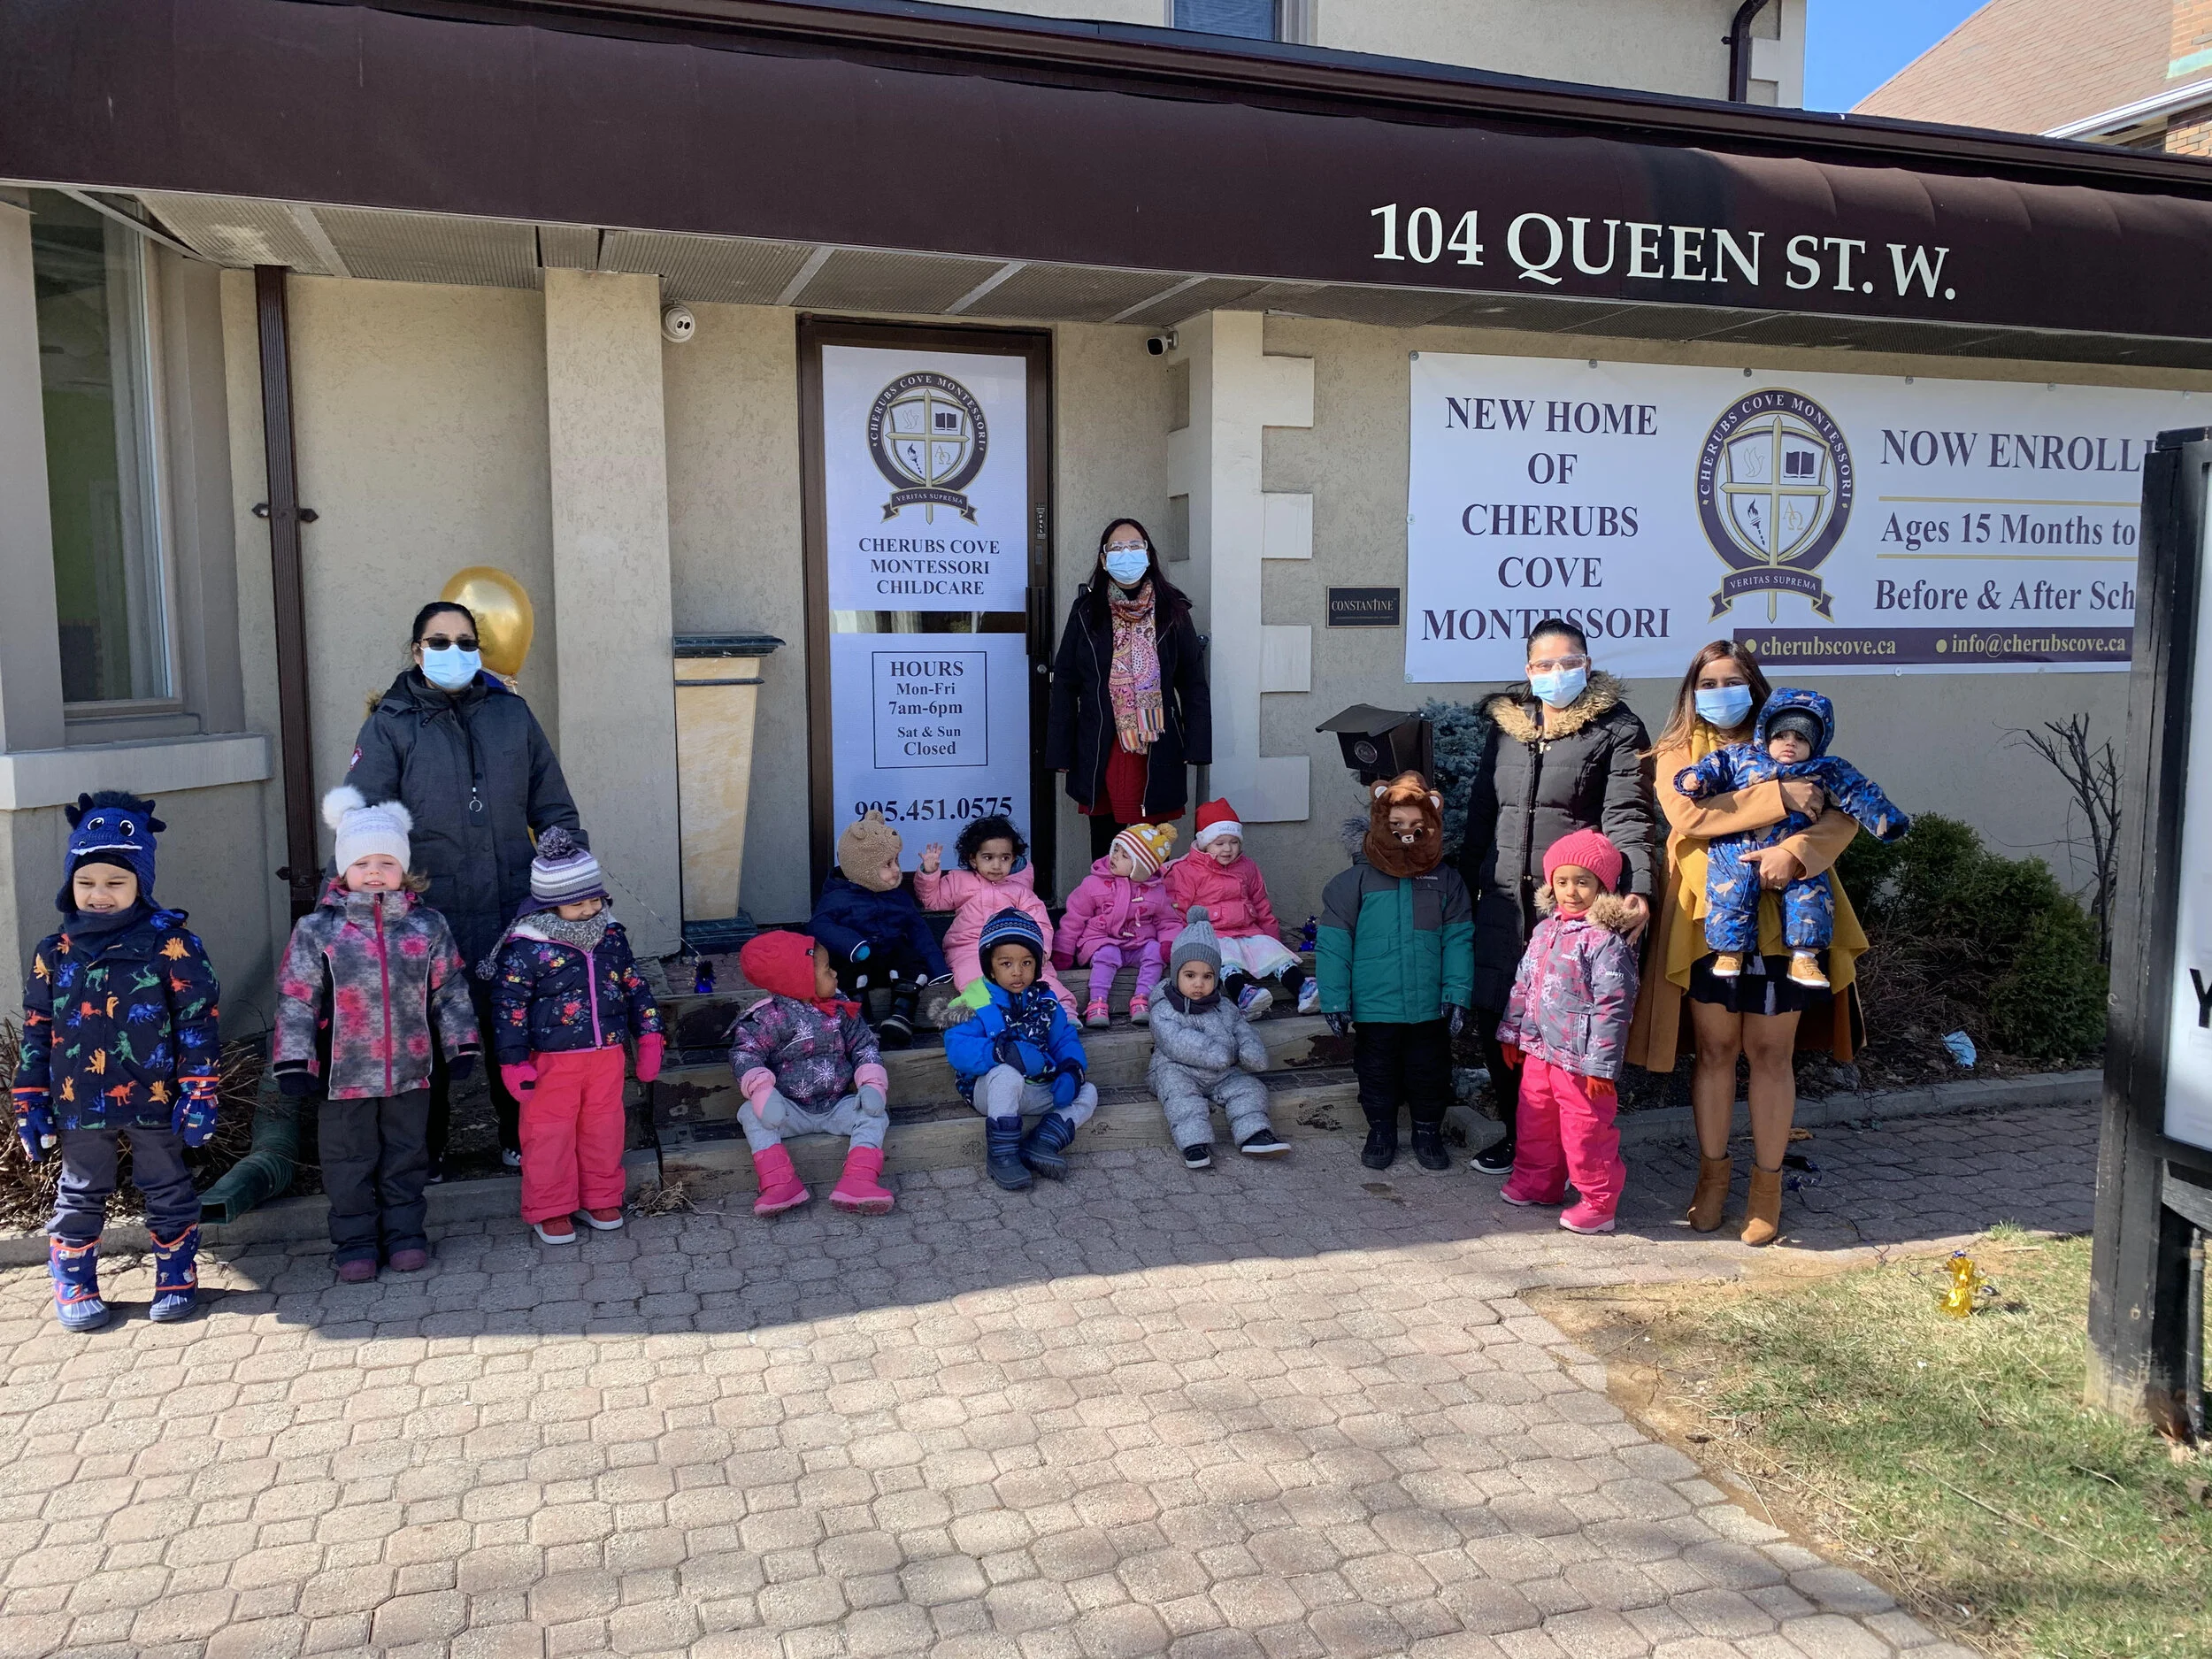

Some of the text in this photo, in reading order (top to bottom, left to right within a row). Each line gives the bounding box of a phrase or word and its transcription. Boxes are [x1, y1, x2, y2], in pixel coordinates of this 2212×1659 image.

[1371, 203, 1484, 265] 104
[1505, 212, 1764, 286] QUEEN
[870, 375, 986, 445] CHERUBS COVE MONTESSORI
[1445, 396, 1658, 435] NEW HOME
[1701, 395, 1851, 498] CHERUBS COVE MONTESSORI
[1880, 429, 1978, 467] NOW
[1528, 452, 1578, 484] OF
[896, 493, 963, 504] VERITAS SUPREMA
[1462, 503, 1638, 537] CHERUBS
[1880, 511, 2136, 550] Ages 15 Months to
[858, 537, 1000, 554] CHERUBS COVE
[870, 559, 989, 574] MONTESSORI
[1498, 557, 1602, 588] COVE
[877, 580, 984, 595] CHILDCARE
[1730, 575, 1816, 590] VERITAS SUPREMA
[1331, 598, 1394, 611] CONSTANTINE
[1875, 579, 2135, 611] Before & After Sch
[1761, 636, 1896, 657] cherubscove.ca
[1952, 634, 2126, 657] info@cherubscove.ca
[890, 661, 964, 677] HOURS
[896, 682, 956, 695] Mon-Fri
[888, 701, 963, 718] 7am-6pm
[897, 726, 961, 738] Sat & Sun
[903, 741, 956, 756] Closed
